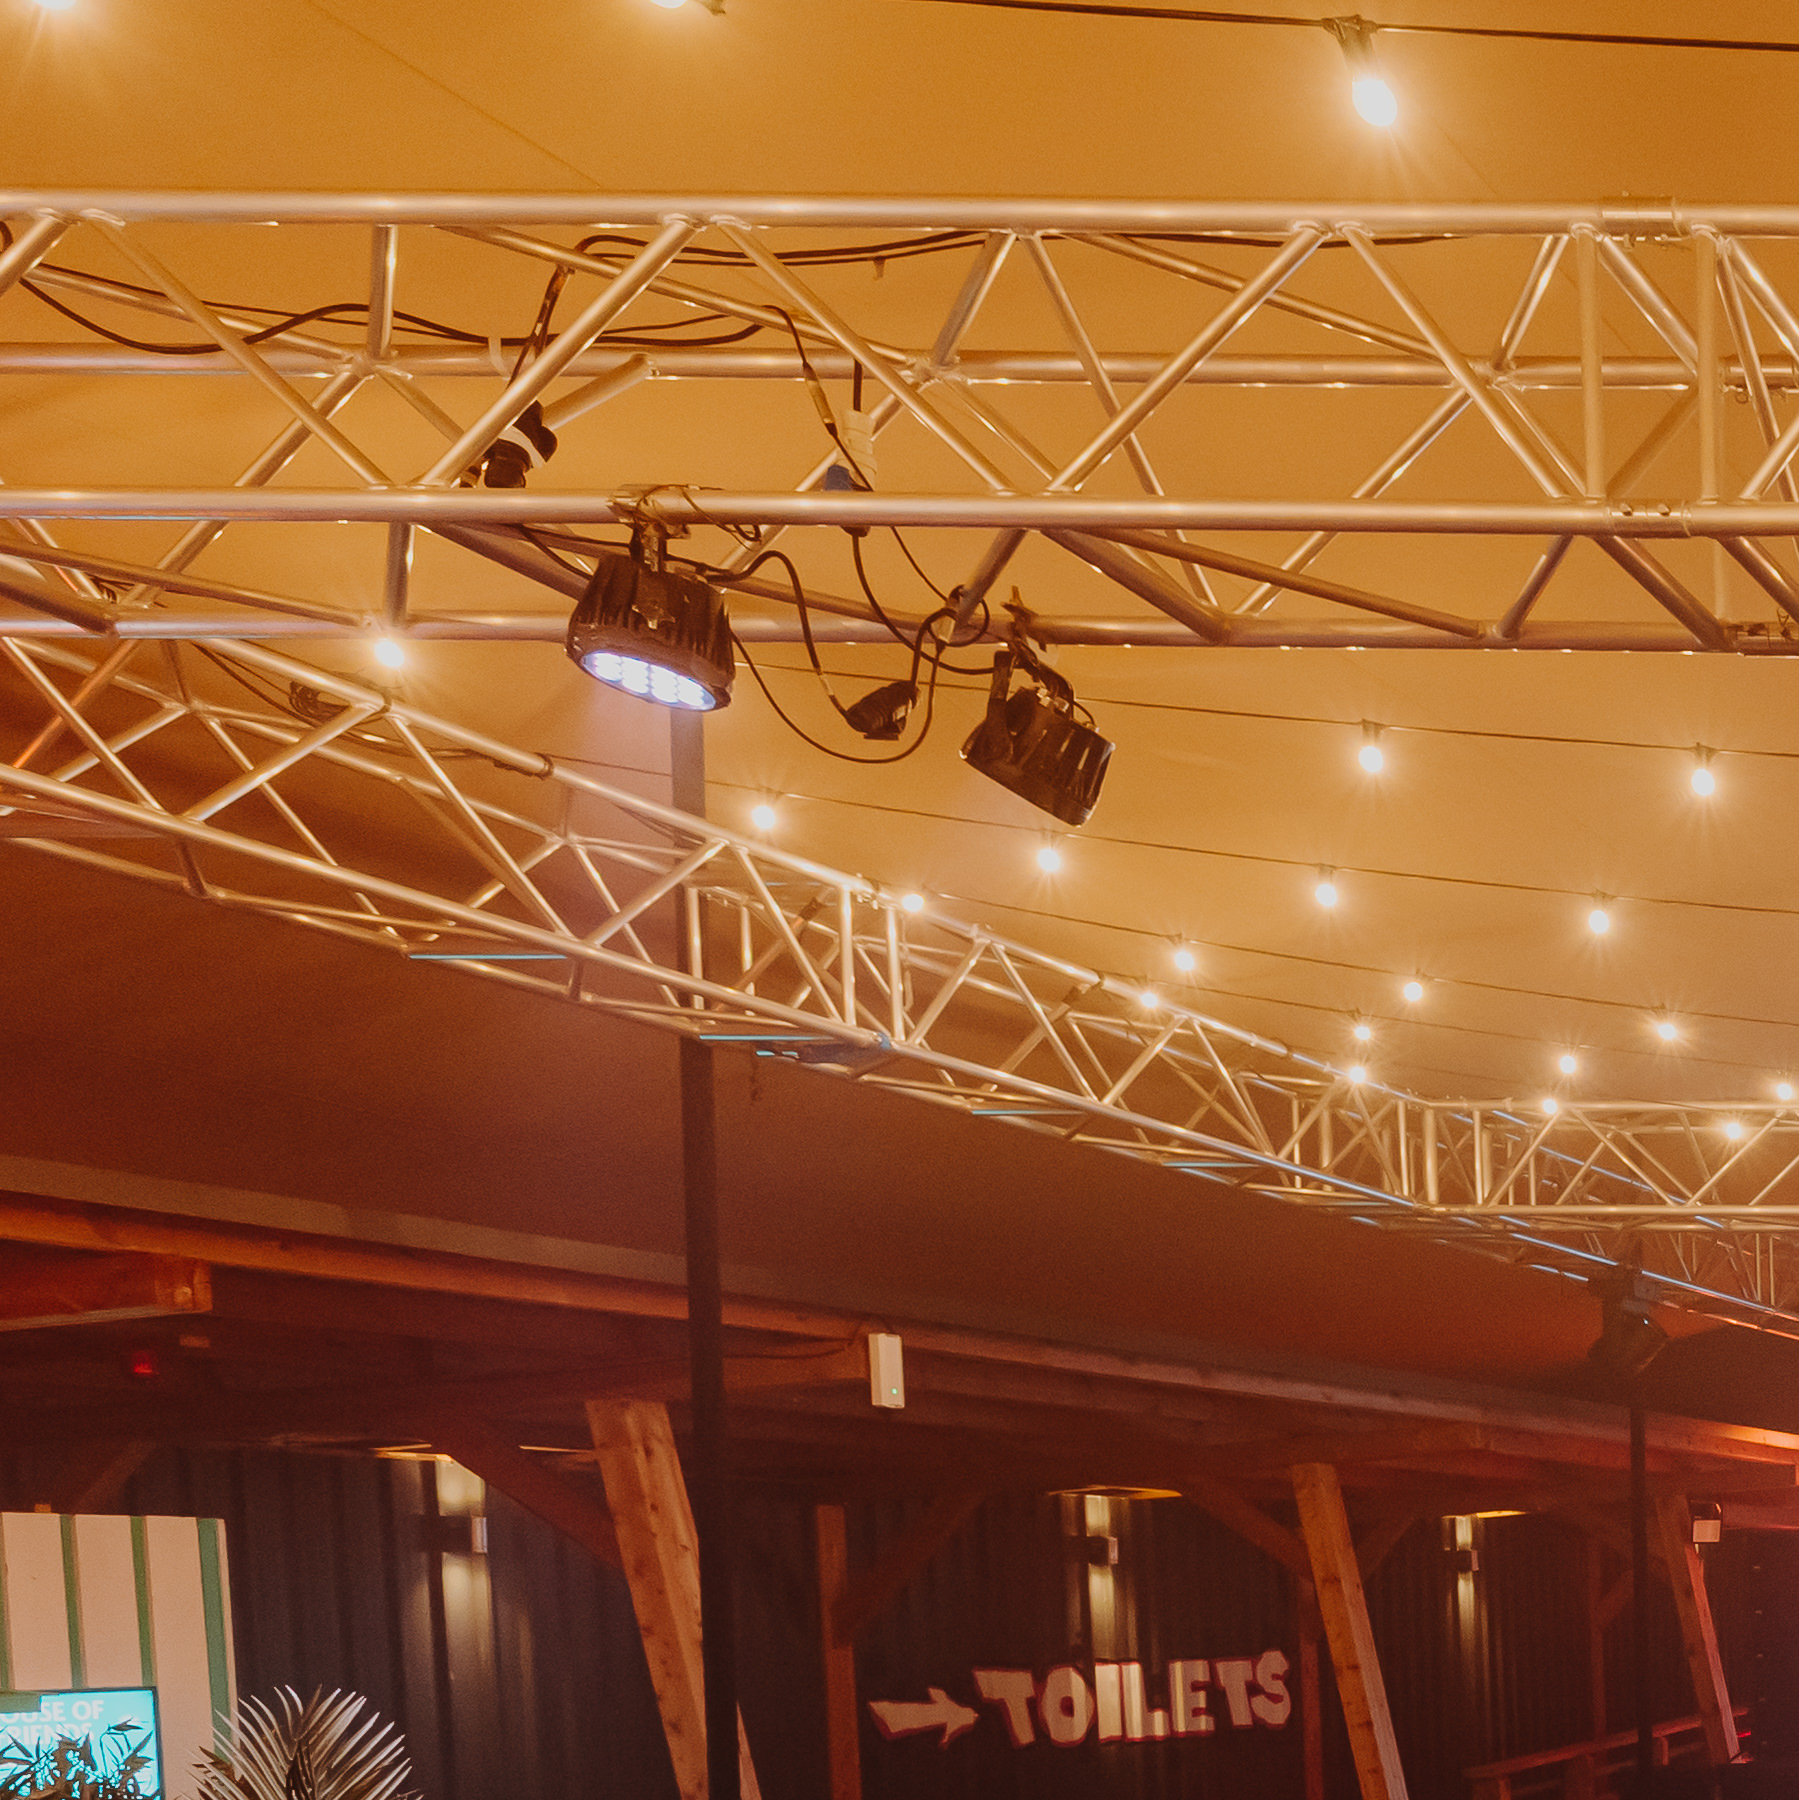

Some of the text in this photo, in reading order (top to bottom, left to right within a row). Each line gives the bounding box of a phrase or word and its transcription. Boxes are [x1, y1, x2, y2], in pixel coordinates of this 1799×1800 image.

[973, 1649, 1292, 1746] TOILETS
[0, 1699, 105, 1722] OUSE OF
[0, 1722, 95, 1745] RIENDS
